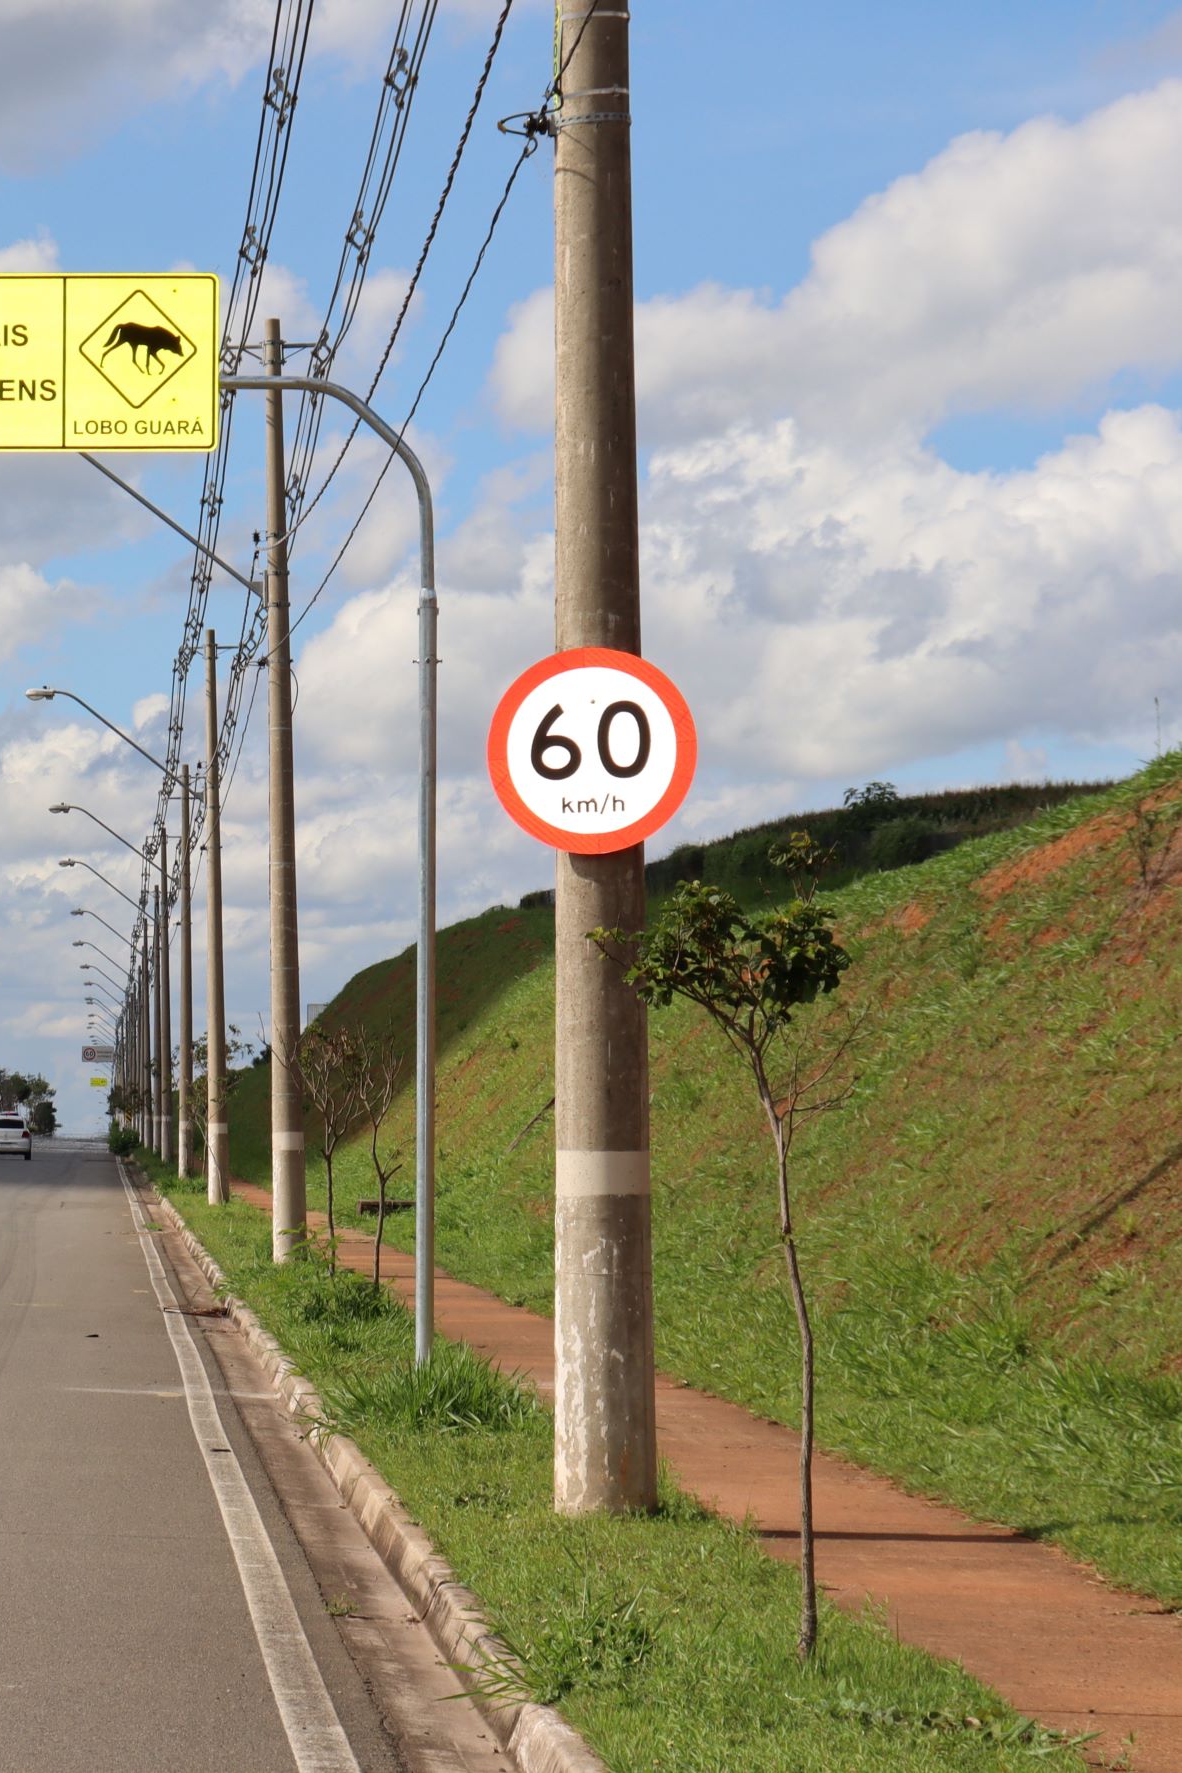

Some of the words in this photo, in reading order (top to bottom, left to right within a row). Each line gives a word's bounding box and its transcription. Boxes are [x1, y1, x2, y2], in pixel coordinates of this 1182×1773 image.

[73, 419, 128, 435] LOBO
[134, 416, 204, 435] GUARÁ
[530, 700, 651, 780] 60
[562, 793, 625, 815] km/h
